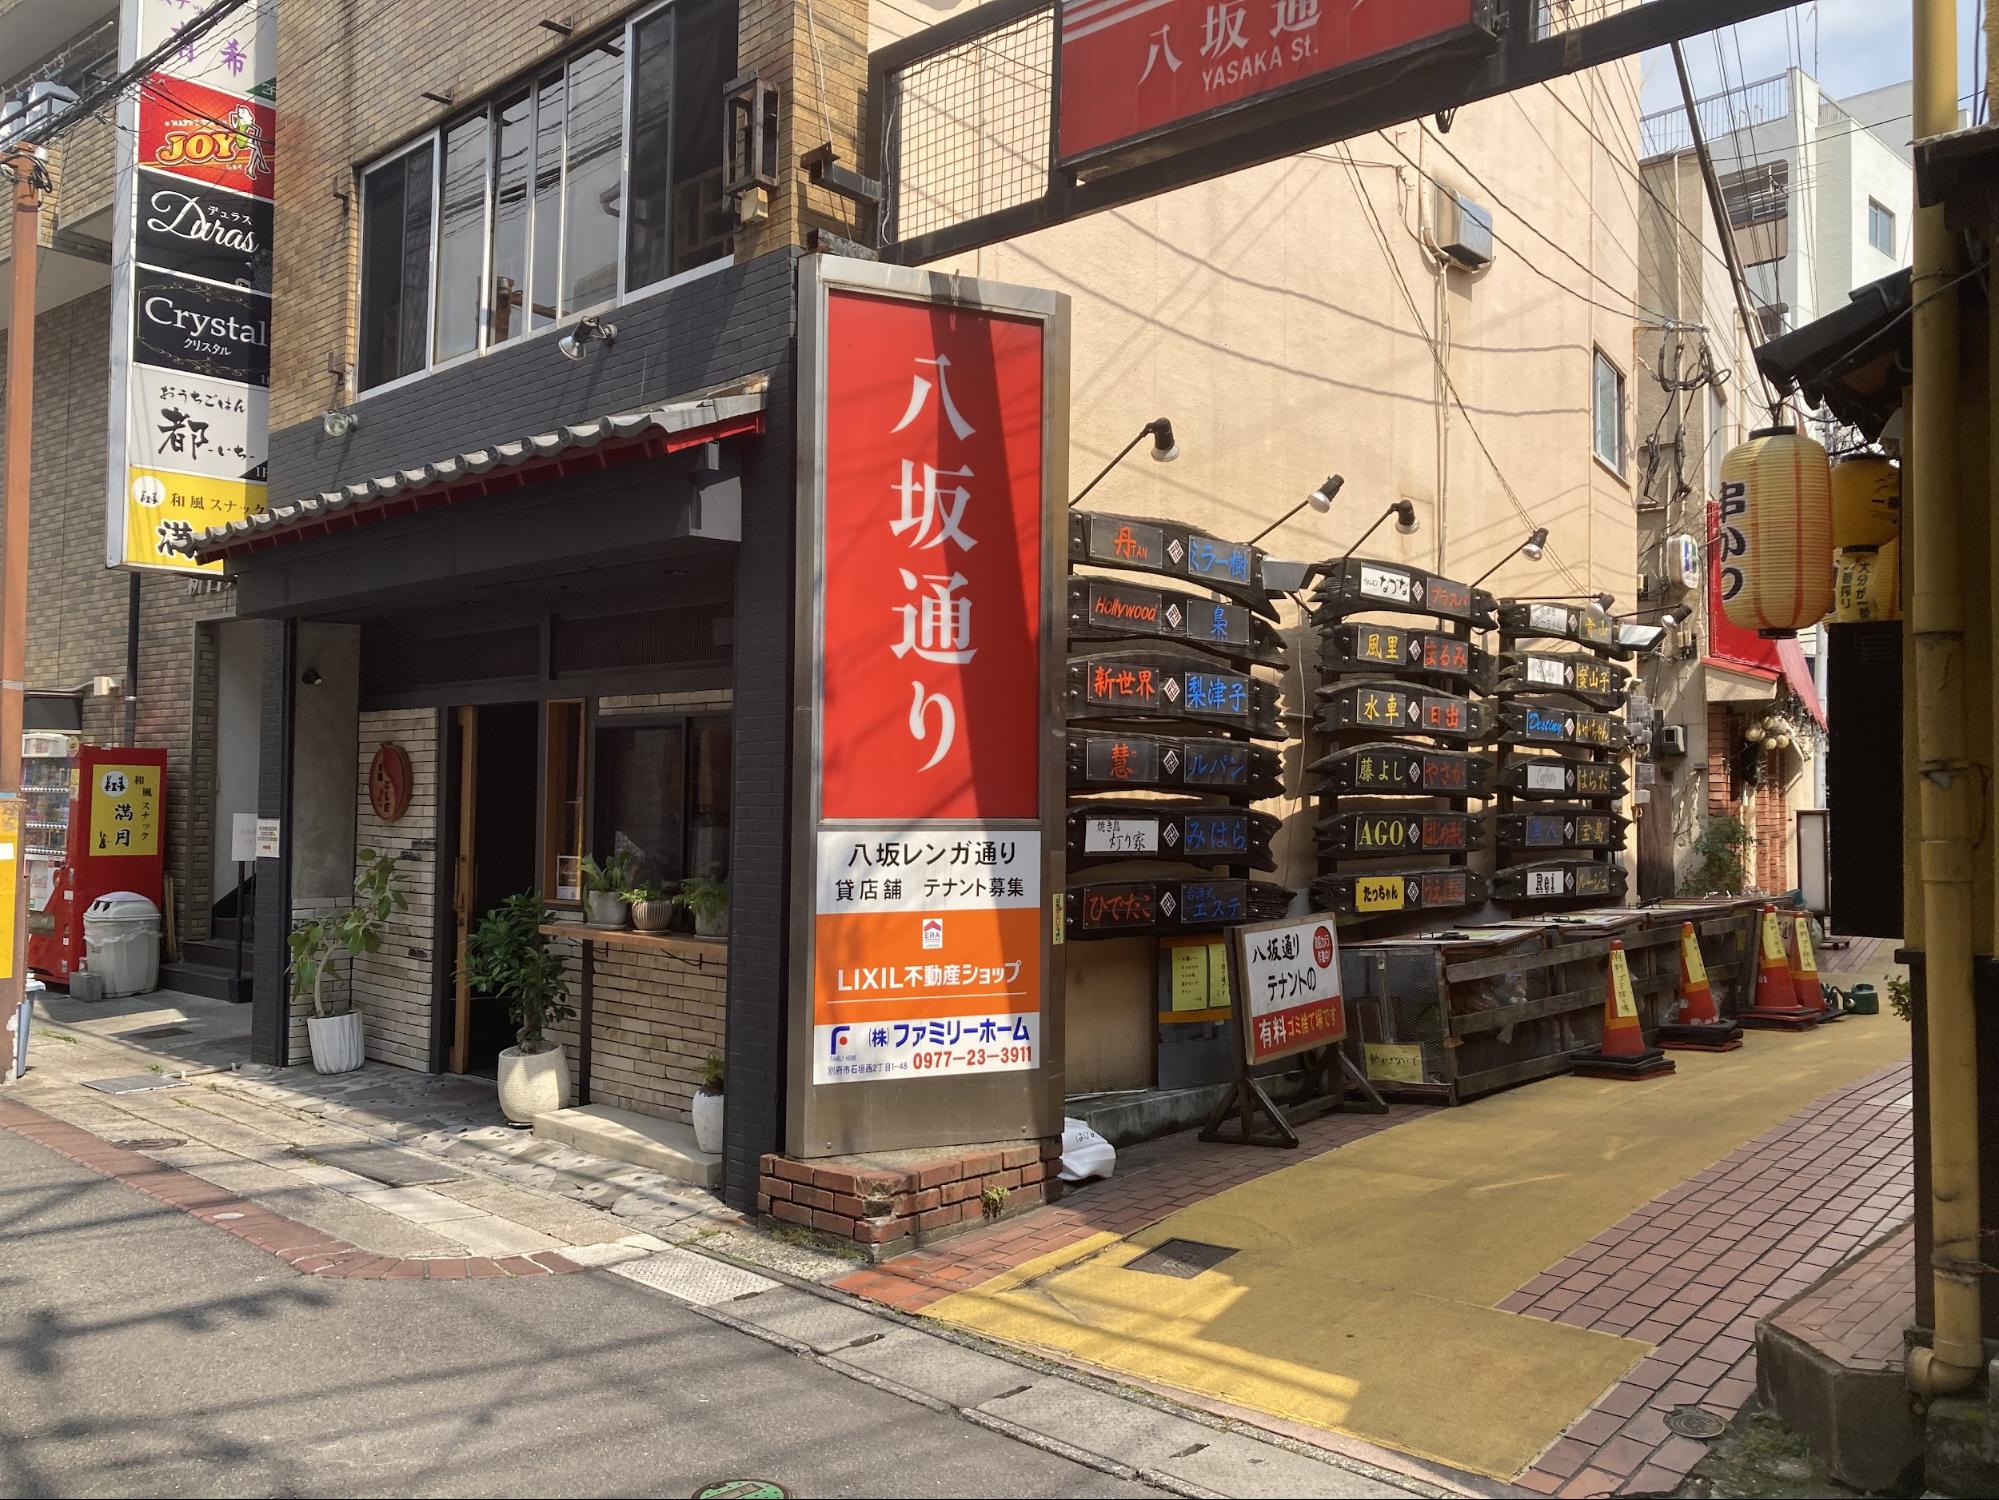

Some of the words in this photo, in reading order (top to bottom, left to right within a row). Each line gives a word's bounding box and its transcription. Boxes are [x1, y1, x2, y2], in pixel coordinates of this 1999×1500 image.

[1138, 0, 1366, 85] 八坂通
[1202, 51, 1284, 93] YASAKA
[1290, 35, 1319, 63] St.
[158, 132, 237, 164] JOY
[147, 190, 260, 253] Duras
[208, 205, 253, 225] デュラス
[145, 296, 267, 347] Crystal
[183, 337, 232, 357] クリスタル
[159, 385, 246, 413] おうちごはん
[170, 492, 266, 515] 和風スナック
[1720, 480, 1747, 601] 串かつ
[889, 353, 978, 773] 八坂通り
[1190, 543, 1249, 581] ミラー樹
[1095, 595, 1158, 622] Hollywood
[1366, 633, 1399, 660] 風里
[1424, 641, 1467, 667] まるみ
[1093, 666, 1156, 700] 新世界
[1187, 675, 1247, 712] 梨津子
[1364, 694, 1399, 725] 水車
[1187, 754, 1246, 779] ルパン
[1359, 757, 1404, 782] 藤よし
[134, 774, 153, 841] 和風スナック
[114, 803, 134, 848] 満月
[1186, 822, 1247, 849] みはら
[1358, 820, 1404, 846] AGO
[848, 841, 1016, 868] 八坂レンガ通り
[1109, 831, 1146, 852] 灯り家
[835, 878, 902, 901] 貸店舗
[924, 877, 1024, 898] テナント募集
[1363, 884, 1399, 903] たっちゃん
[1536, 873, 1556, 893] Rei
[1252, 933, 1300, 964] 八坂通り
[1267, 967, 1317, 1002] テナントの
[912, 1045, 1032, 1070] 0977-23-3911
